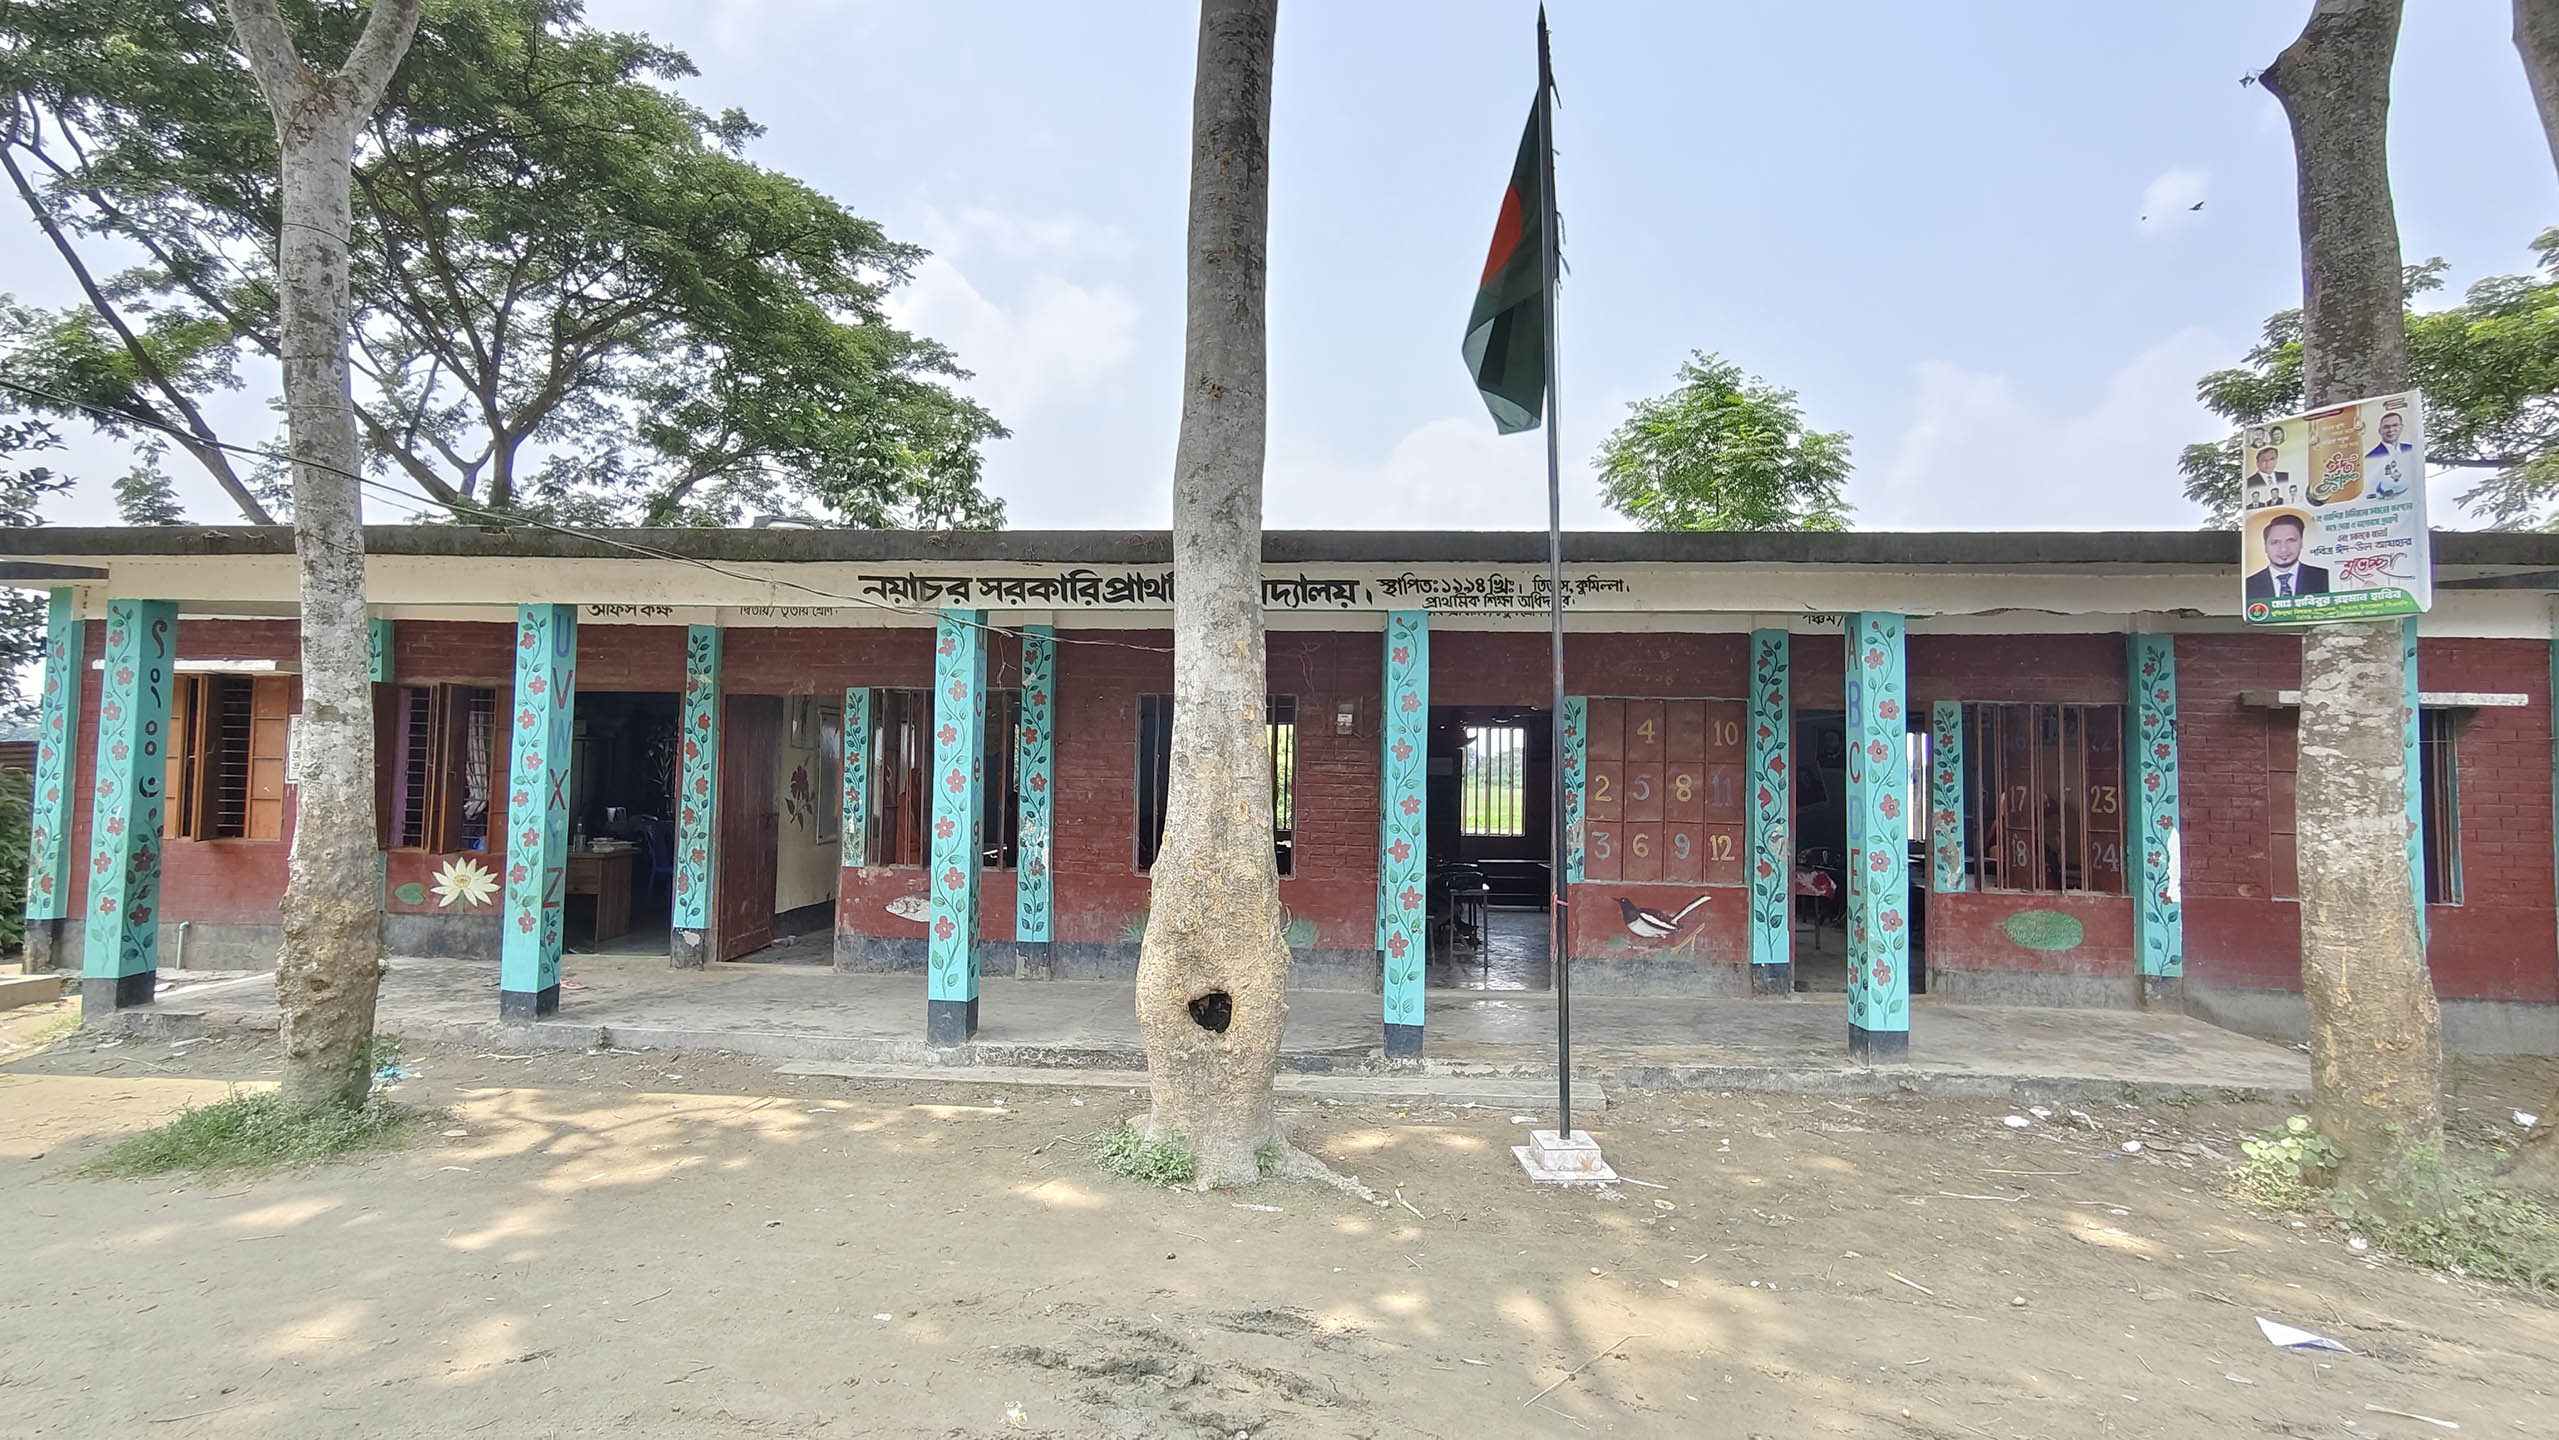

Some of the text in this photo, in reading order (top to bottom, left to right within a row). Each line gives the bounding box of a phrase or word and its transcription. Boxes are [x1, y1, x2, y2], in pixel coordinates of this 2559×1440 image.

[858, 571, 973, 604] নয়াচর
[976, 569, 1102, 605] সরকারি
[1532, 575, 1573, 594] তিতস,
[1575, 575, 1630, 596] কুমিল্লা।
[1422, 593, 1480, 609] প্রাথমিক
[1483, 592, 1514, 608] শিক্ষা
[554, 614, 571, 657] U
[1846, 626, 1858, 673] A
[552, 667, 573, 709] V
[1849, 680, 1861, 728] B
[1636, 720, 1655, 744] 4
[1713, 721, 1739, 746] 10
[1849, 741, 1861, 784] C
[548, 769, 569, 810] X
[1594, 775, 1612, 802] 2
[1632, 774, 1651, 800] 5
[1675, 774, 1692, 802] 8
[2010, 785, 2027, 813] 17
[2090, 785, 2117, 813] 23
[1592, 831, 1611, 860] 3
[1632, 833, 1649, 857] 6
[1674, 833, 1691, 859] 9
[1709, 834, 1735, 861] 12
[2011, 837, 2028, 867] 18
[2092, 841, 2120, 872] 24
[1850, 849, 1861, 896] E
[542, 867, 563, 908] Z
